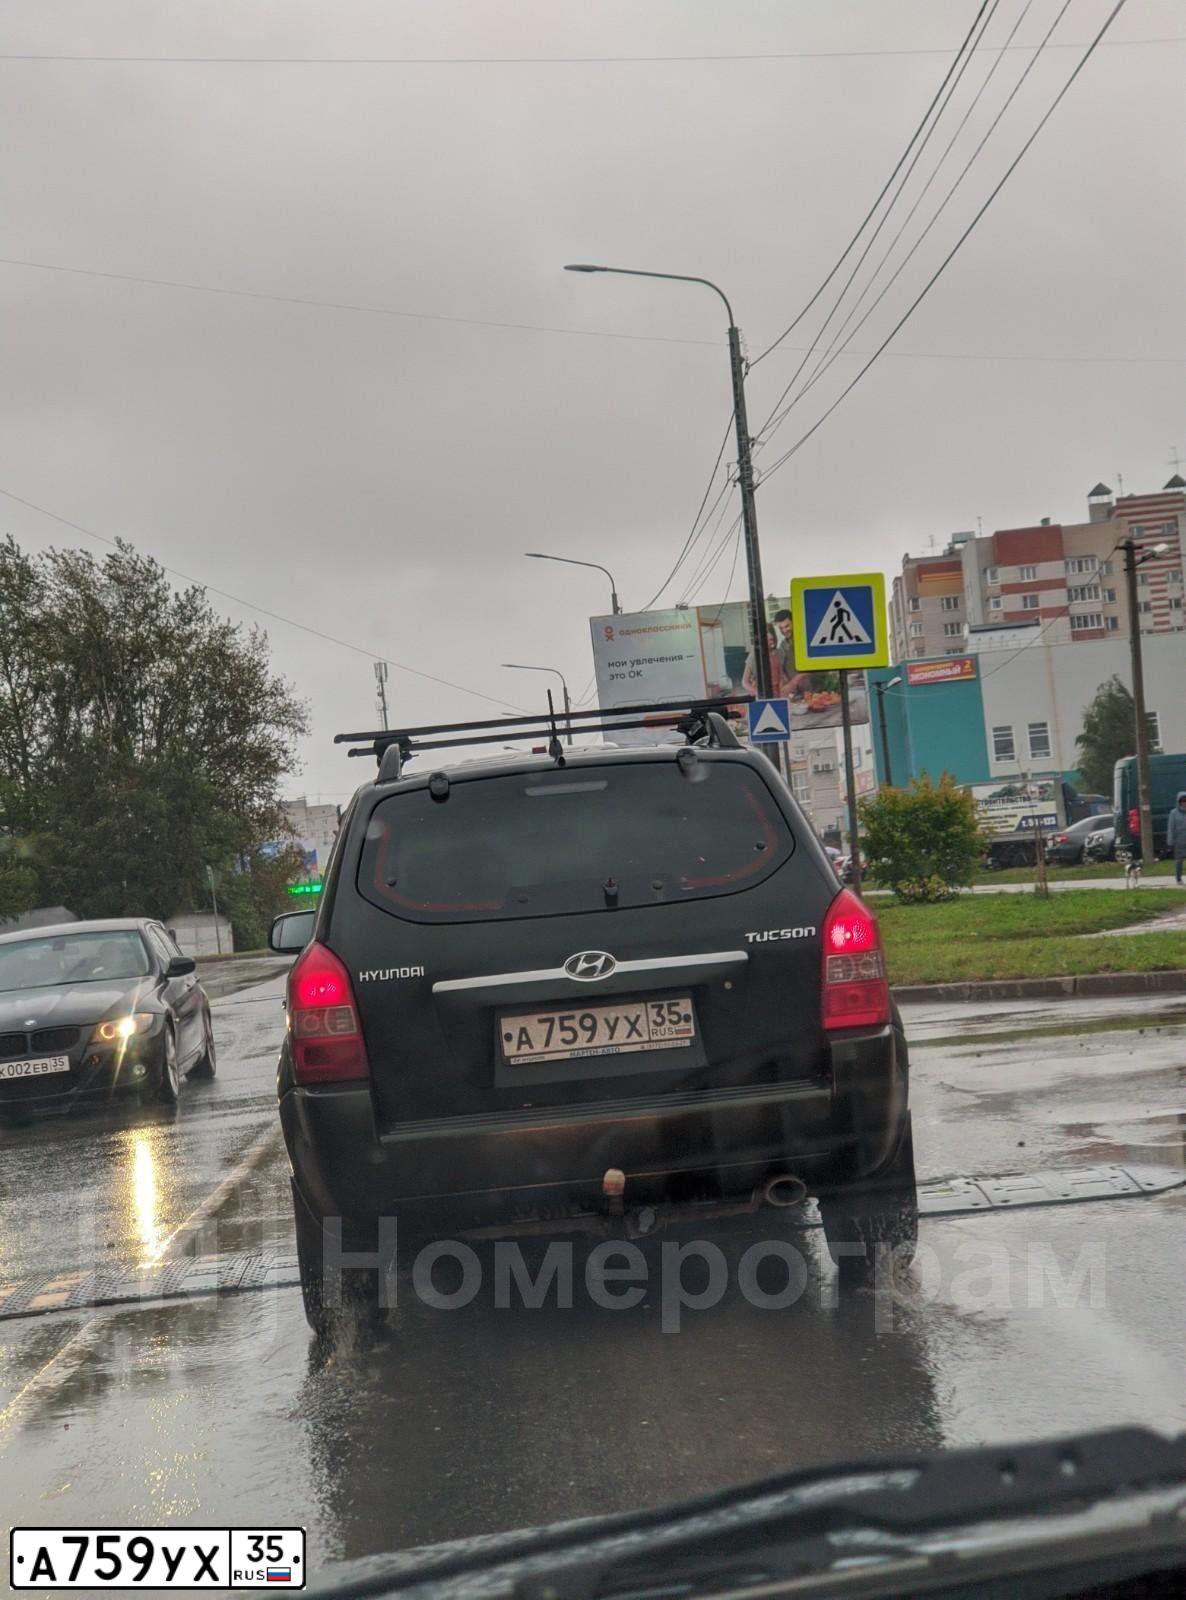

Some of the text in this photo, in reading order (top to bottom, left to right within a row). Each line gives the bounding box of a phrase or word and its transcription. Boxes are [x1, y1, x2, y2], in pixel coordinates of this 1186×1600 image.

[619, 623, 692, 636] одноклассники
[608, 660, 627, 668] мои
[629, 654, 683, 668] увлечения
[609, 672, 626, 680] это
[745, 926, 815, 943] TUCSON
[360, 966, 425, 982] HYUNDAI
[516, 1002, 682, 1051] А759УХ 35
[652, 1027, 674, 1037] RUS
[52, 1057, 65, 1067] 35
